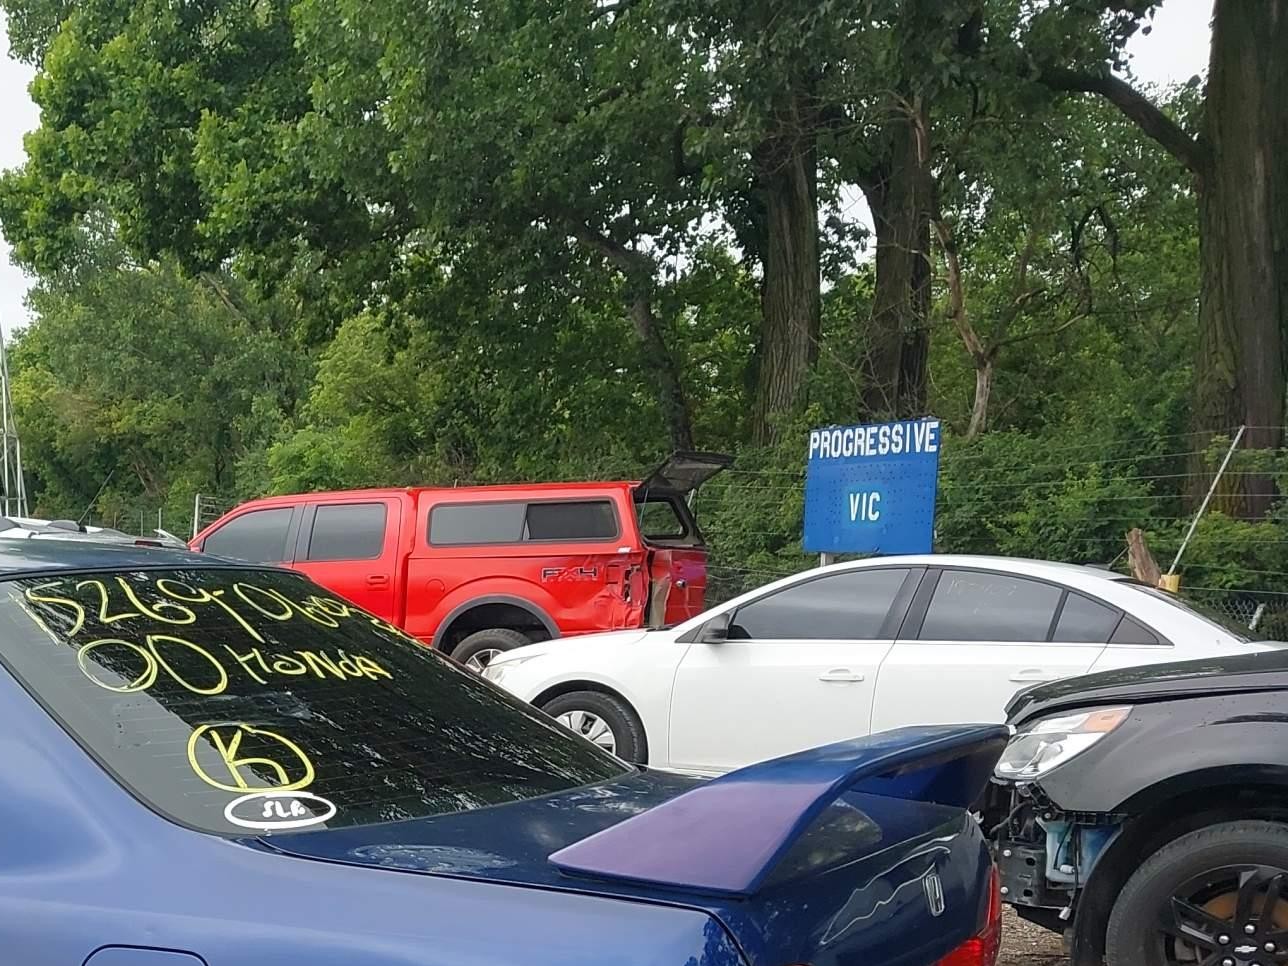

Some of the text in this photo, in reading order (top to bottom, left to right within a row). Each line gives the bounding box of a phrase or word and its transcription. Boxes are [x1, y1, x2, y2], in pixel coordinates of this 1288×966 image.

[808, 421, 939, 459] PROGRESSIVE
[848, 492, 881, 521] VIC
[541, 567, 599, 582] FX4
